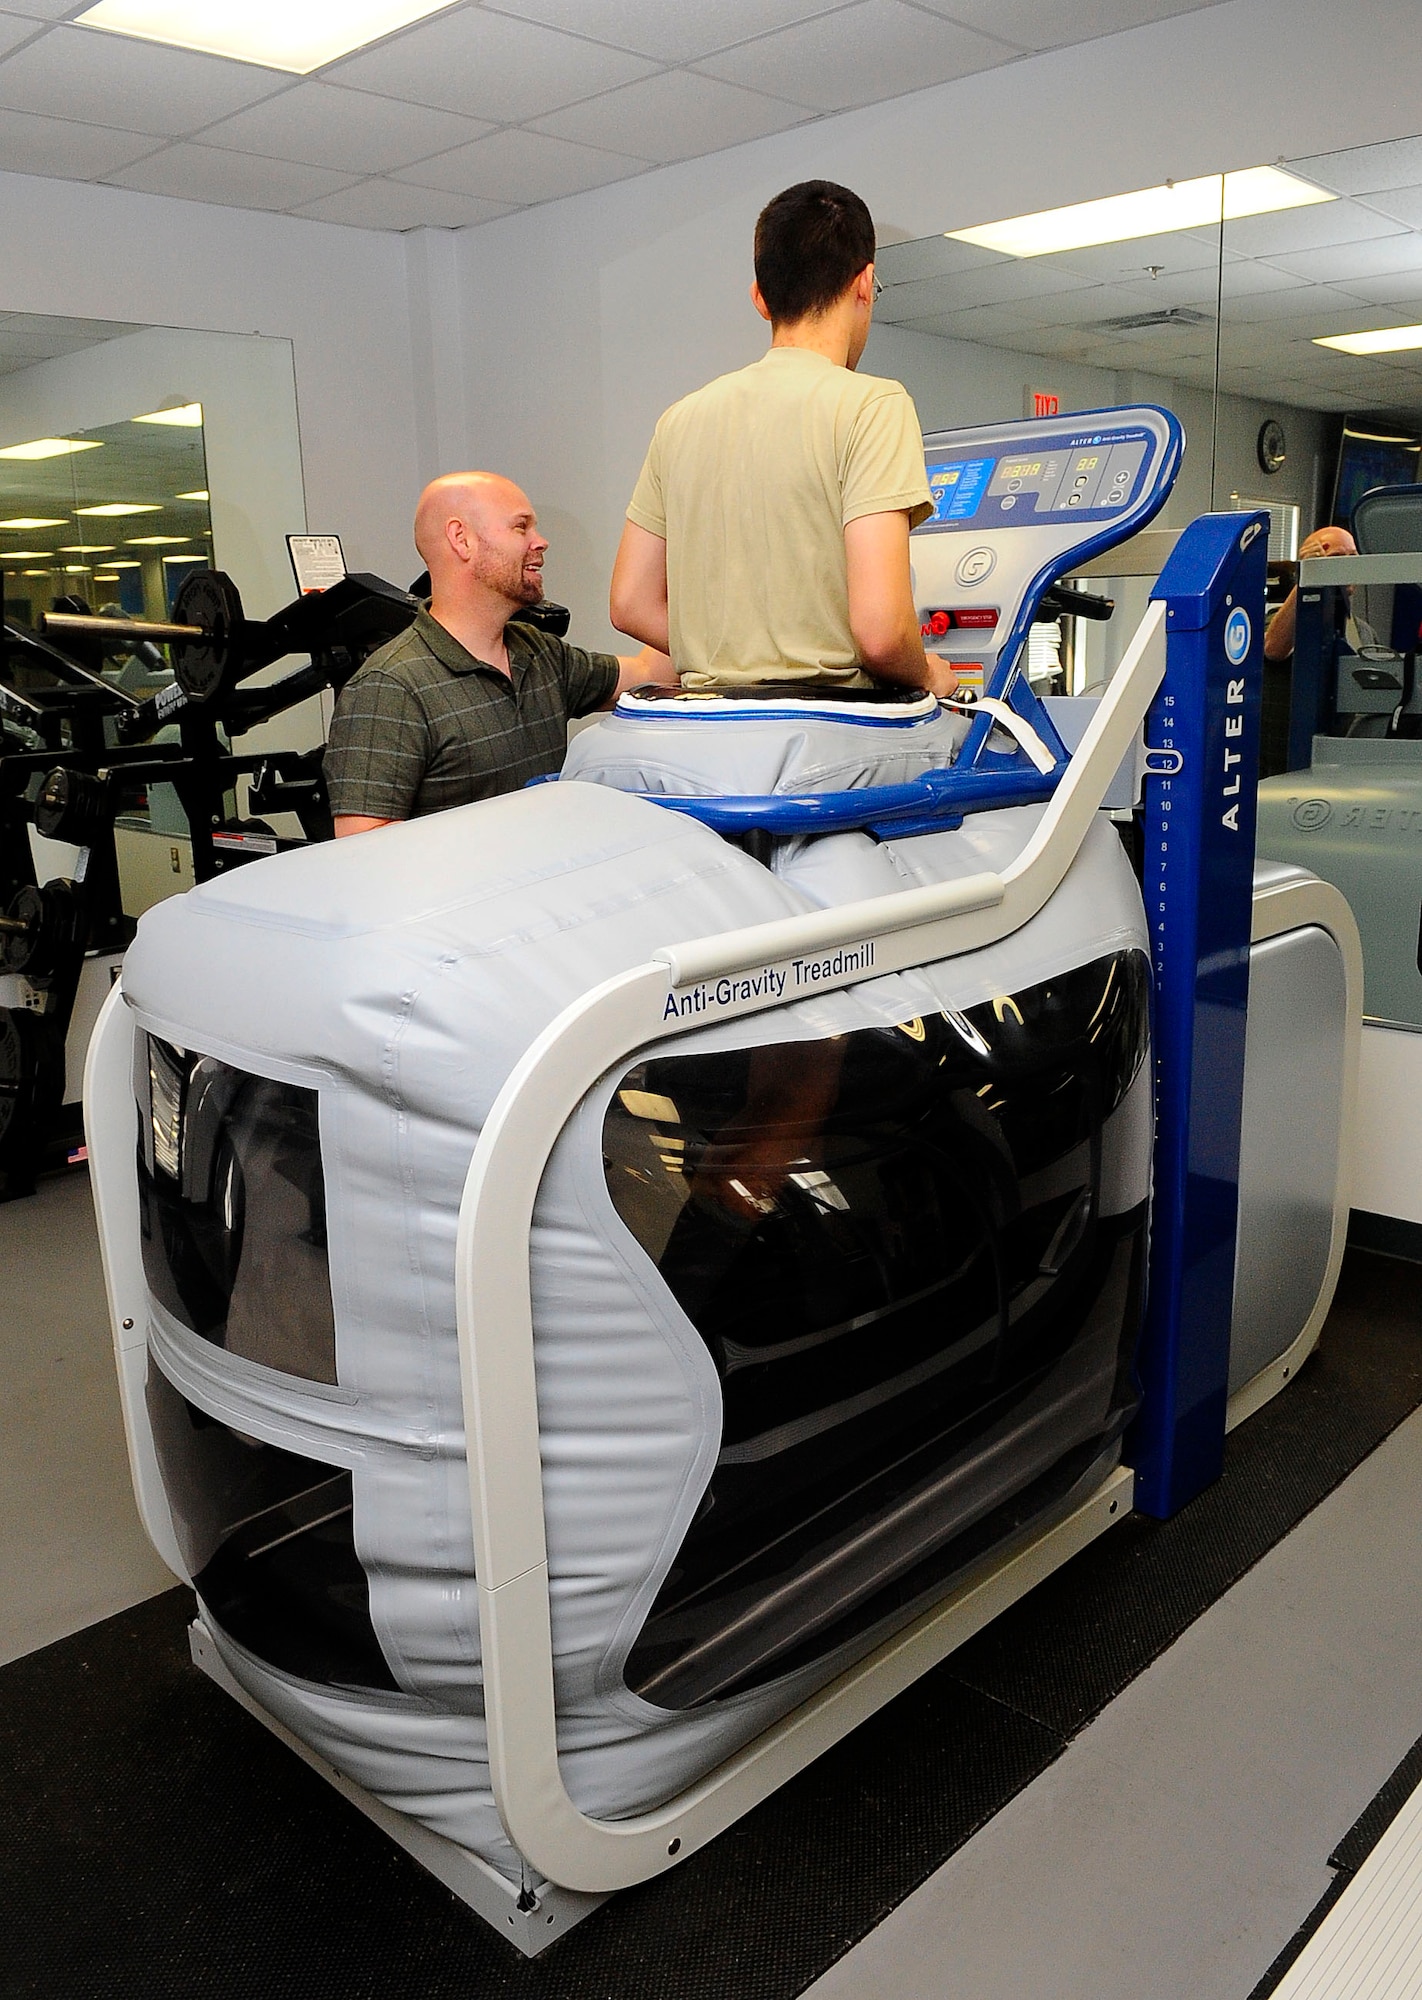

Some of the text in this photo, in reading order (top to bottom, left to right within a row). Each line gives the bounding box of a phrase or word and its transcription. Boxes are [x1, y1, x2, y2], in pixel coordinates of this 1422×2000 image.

[1070, 437, 1092, 446] ALTER
[1163, 696, 1175, 707] 15
[1162, 717, 1174, 728] 14
[1162, 738, 1174, 749] 13
[1222, 678, 1245, 832] ALTER
[1161, 759, 1173, 769] 12
[1161, 780, 1171, 790] 11
[1160, 801, 1171, 811] 10
[1161, 822, 1168, 831] 9
[1161, 842, 1168, 852] 8
[1160, 862, 1167, 872] 7
[1159, 882, 1166, 892] 6
[1159, 902, 1166, 912] 5
[1158, 922, 1165, 932] 4
[1157, 942, 1164, 952] 3
[1157, 962, 1163, 972] 2
[663, 942, 875, 1021] Anti-Gravity Treadmill
[1157, 982, 1162, 991] 1
